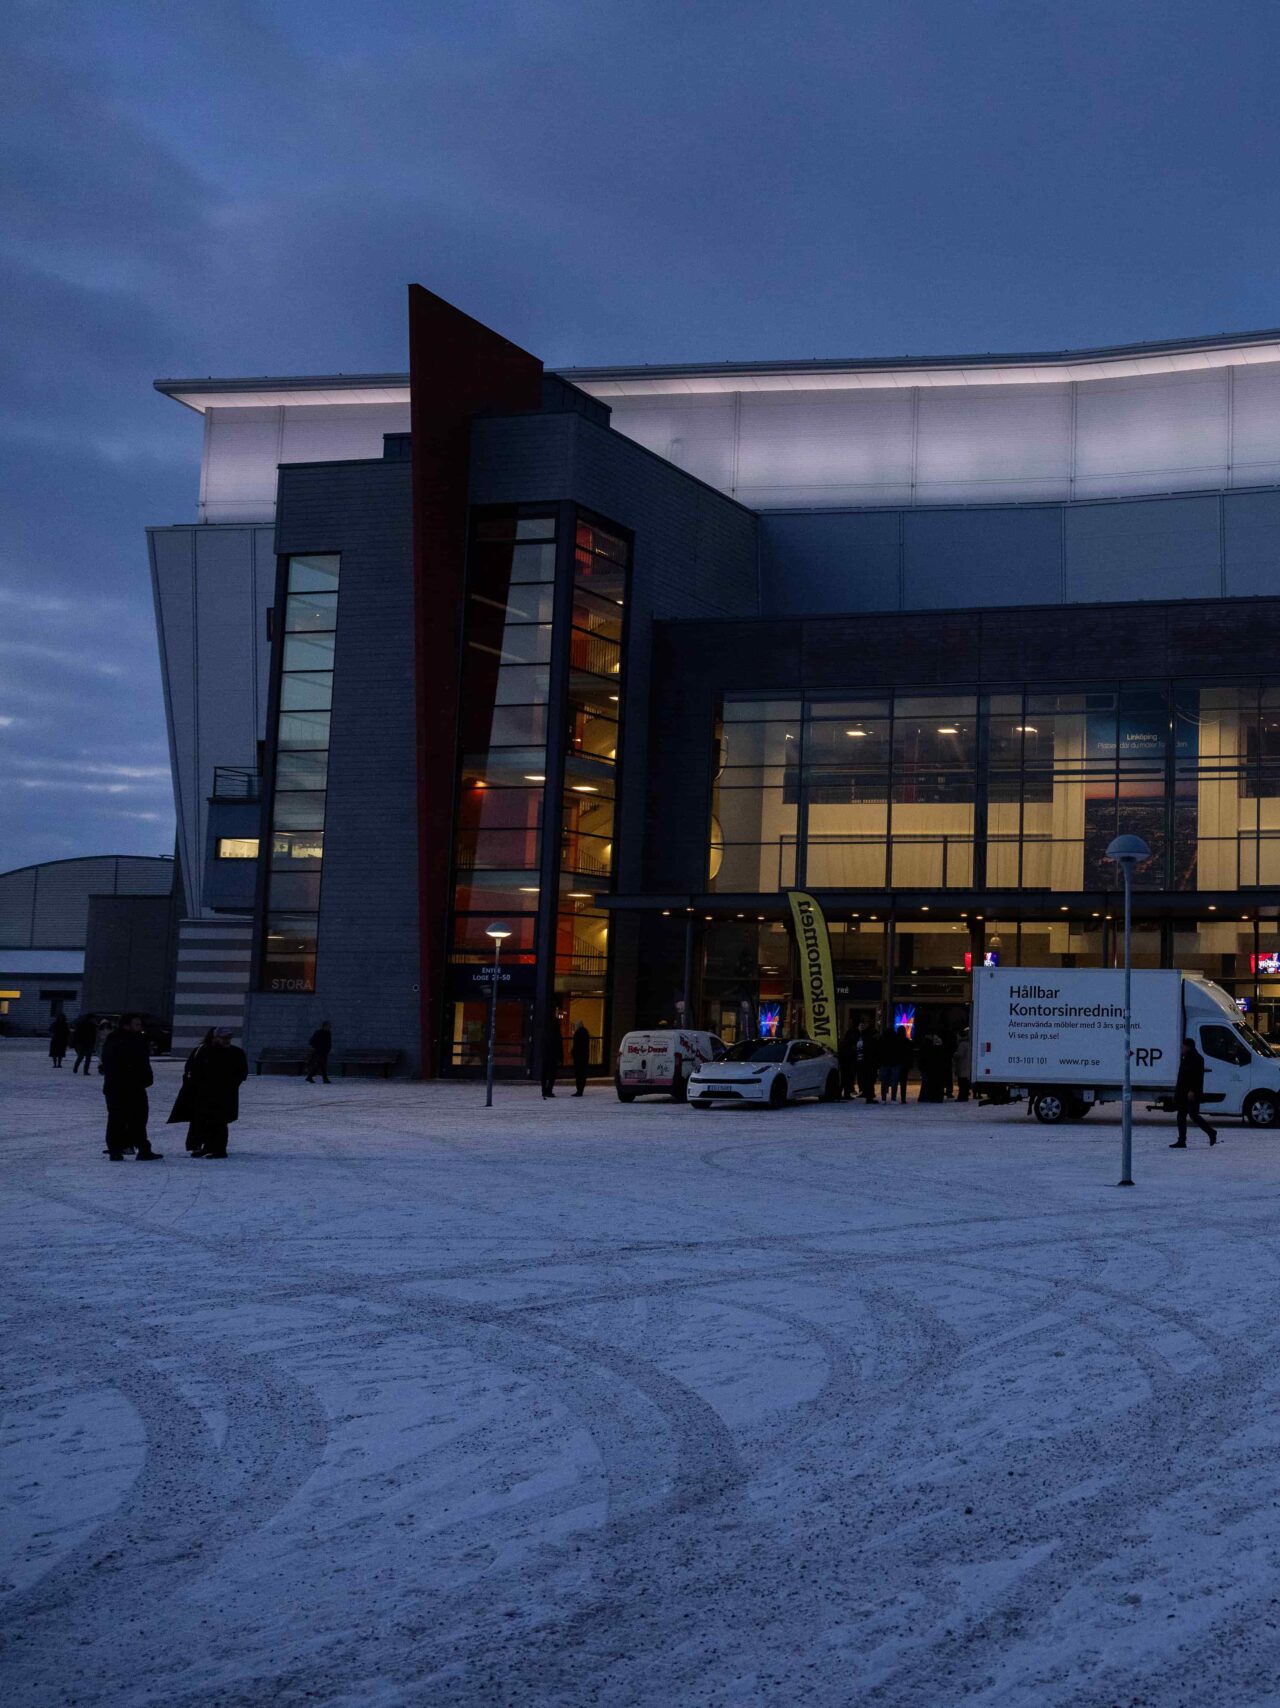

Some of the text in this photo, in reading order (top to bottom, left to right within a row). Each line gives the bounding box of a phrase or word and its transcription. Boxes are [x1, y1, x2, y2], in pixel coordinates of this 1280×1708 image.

[271, 978, 314, 991] STORA
[1009, 985, 1061, 999] Hållbar
[1008, 1019, 1053, 1028] Återanvända
[1054, 1020, 1078, 1029] möbler
[1080, 1021, 1095, 1029] med
[1030, 1032, 1039, 1040] på
[1059, 1057, 1100, 1067] www.rp.se
[1135, 1047, 1163, 1067] RP
